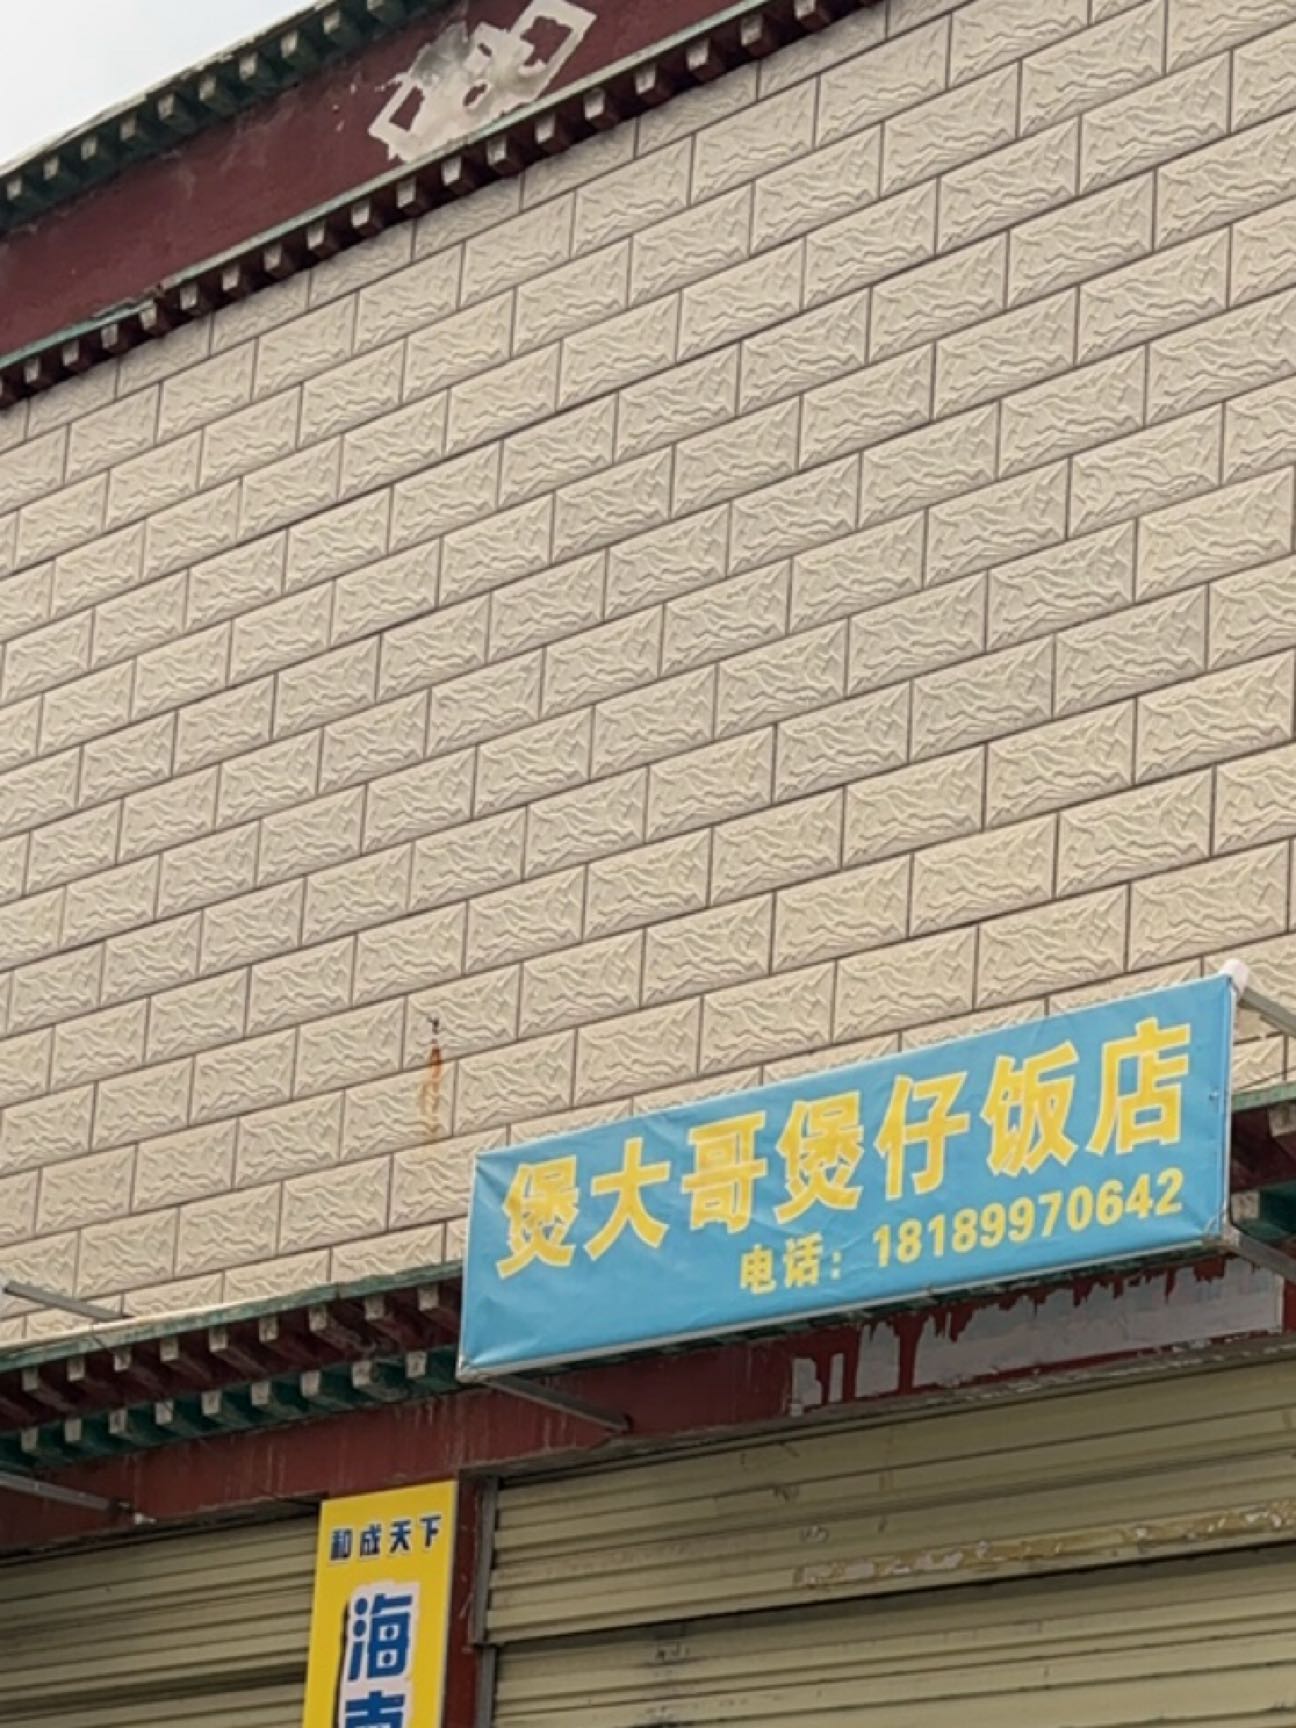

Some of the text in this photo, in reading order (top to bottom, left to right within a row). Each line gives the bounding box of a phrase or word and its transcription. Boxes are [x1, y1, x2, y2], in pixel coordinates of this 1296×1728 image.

[497, 1016, 1192, 1278] 煲大哥煲仔饭店
[873, 1167, 1184, 1268] 18189970642
[330, 1514, 441, 1561] 和成天下
